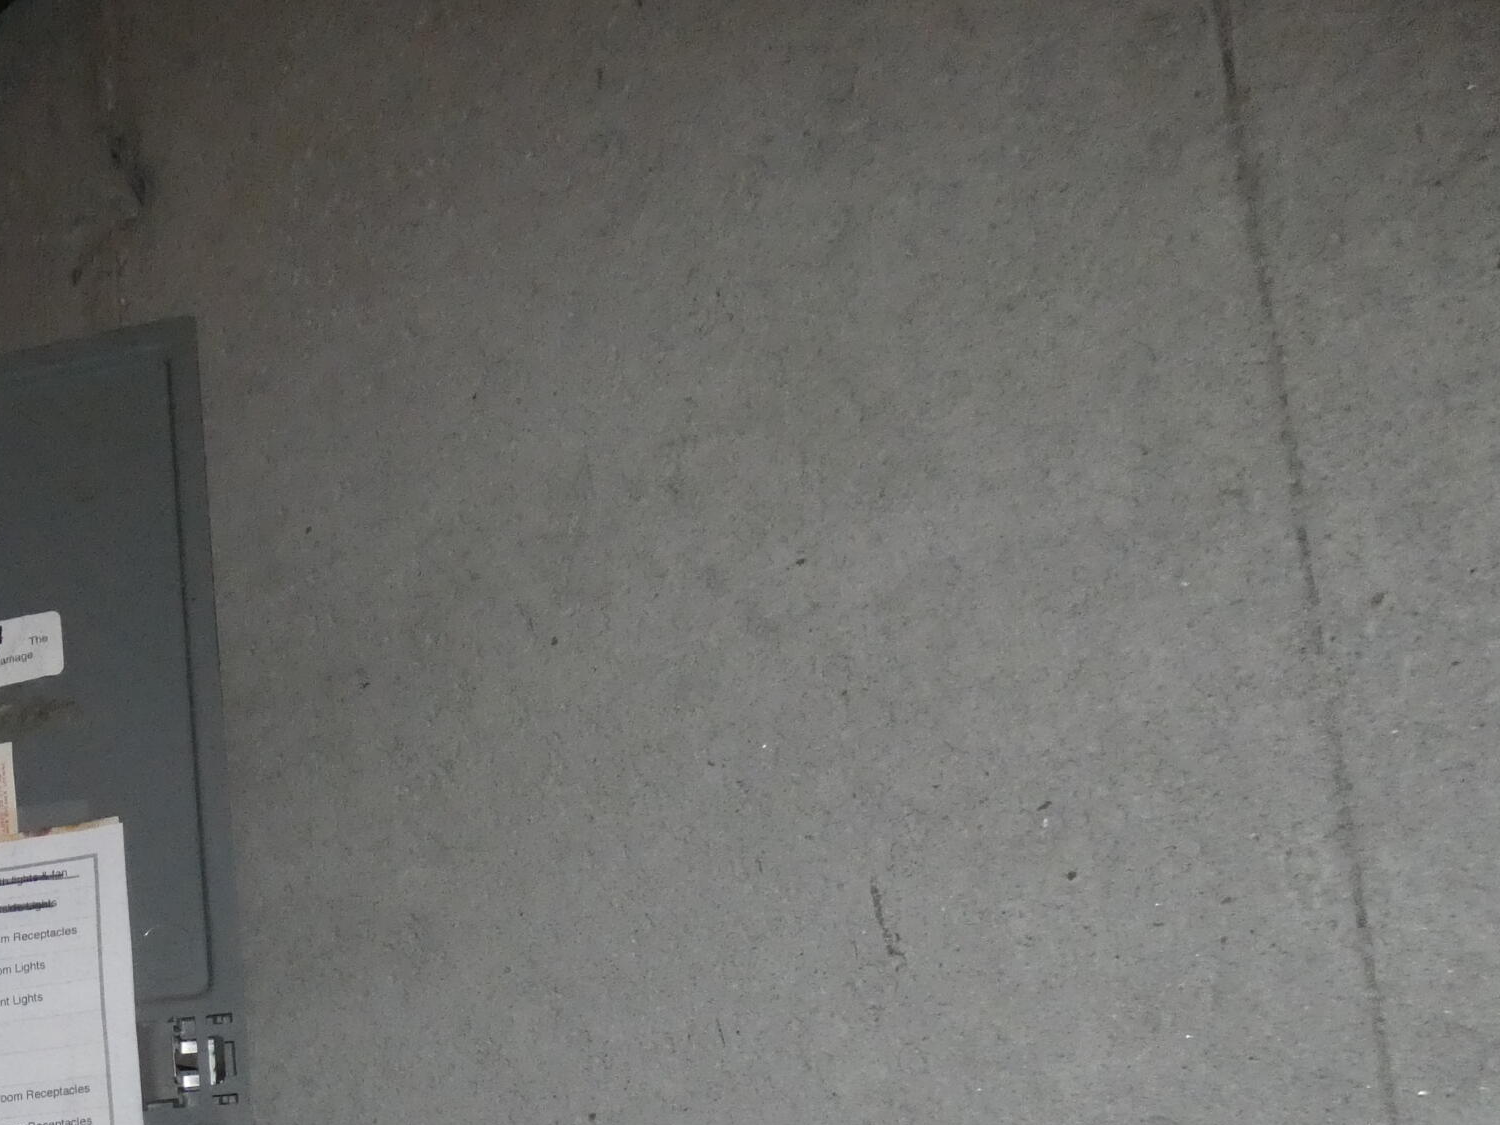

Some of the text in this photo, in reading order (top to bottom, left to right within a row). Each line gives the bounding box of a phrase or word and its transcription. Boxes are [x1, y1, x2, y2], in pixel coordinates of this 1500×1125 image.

[29, 635, 49, 646] The
[13, 926, 77, 941] Receptacles
[15, 960, 46, 973] Lights
[13, 993, 43, 1006] Lights
[26, 1084, 90, 1100] Receptacles
